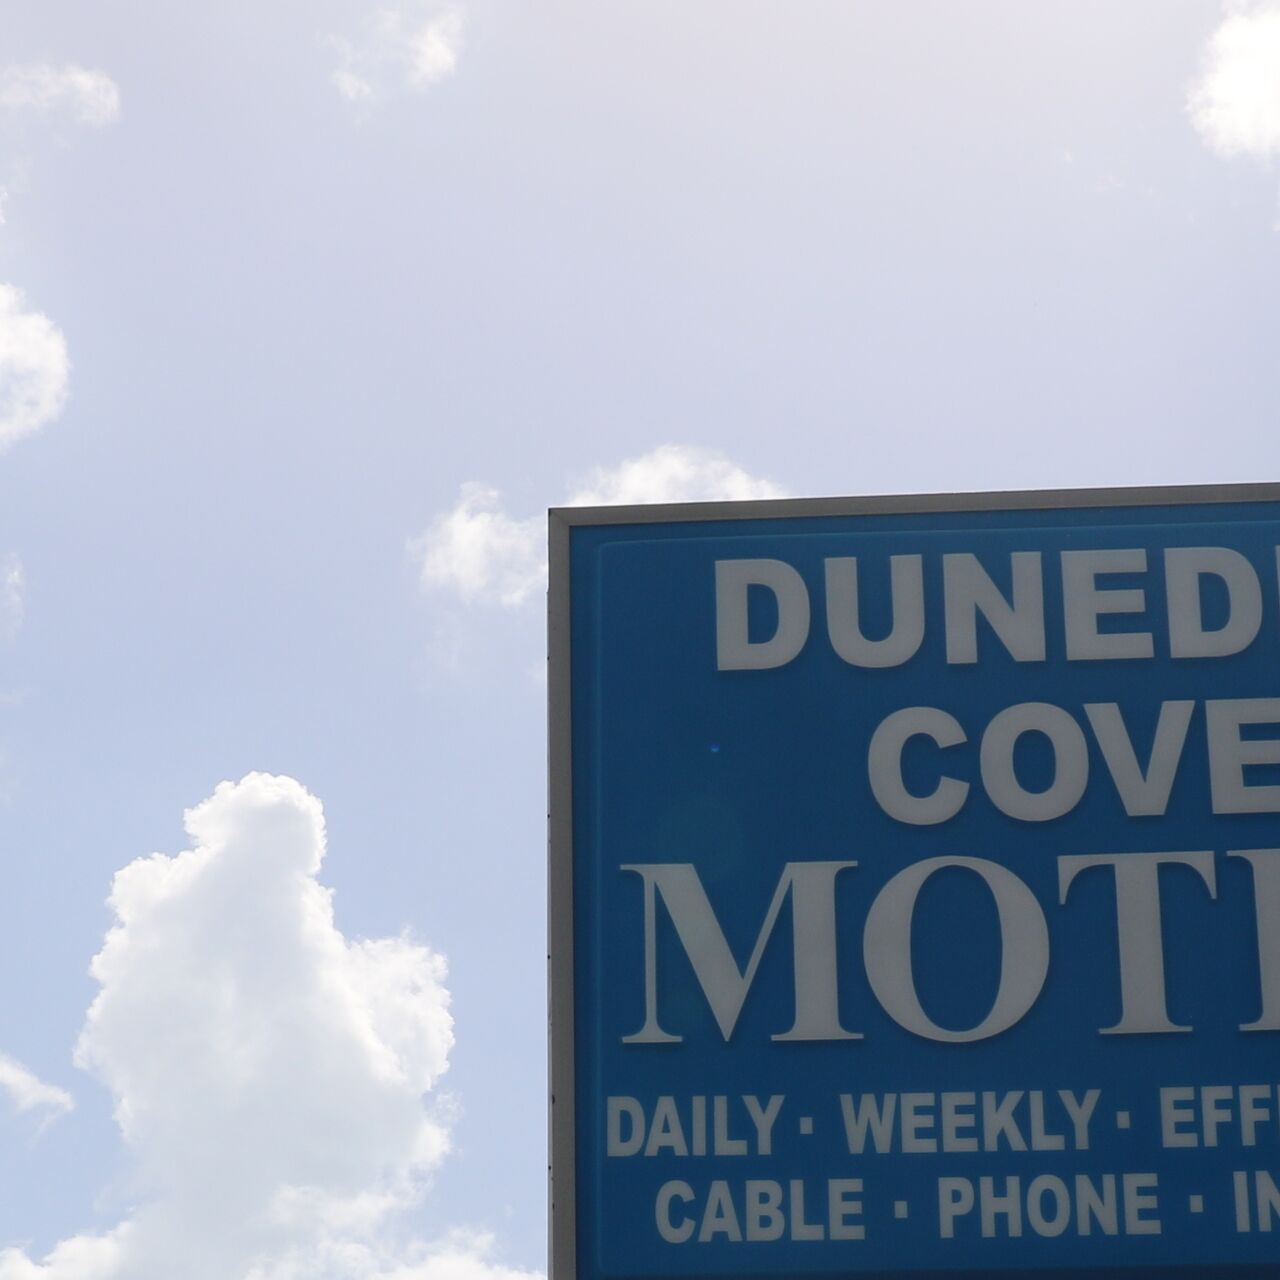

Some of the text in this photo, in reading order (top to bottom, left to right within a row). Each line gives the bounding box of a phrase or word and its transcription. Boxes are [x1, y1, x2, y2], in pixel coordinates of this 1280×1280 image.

[607, 1095, 784, 1157] DAILY
[841, 1090, 1100, 1155] WEEKLY
[655, 1178, 865, 1244] CABLE
[938, 1172, 1160, 1238] PHONE
